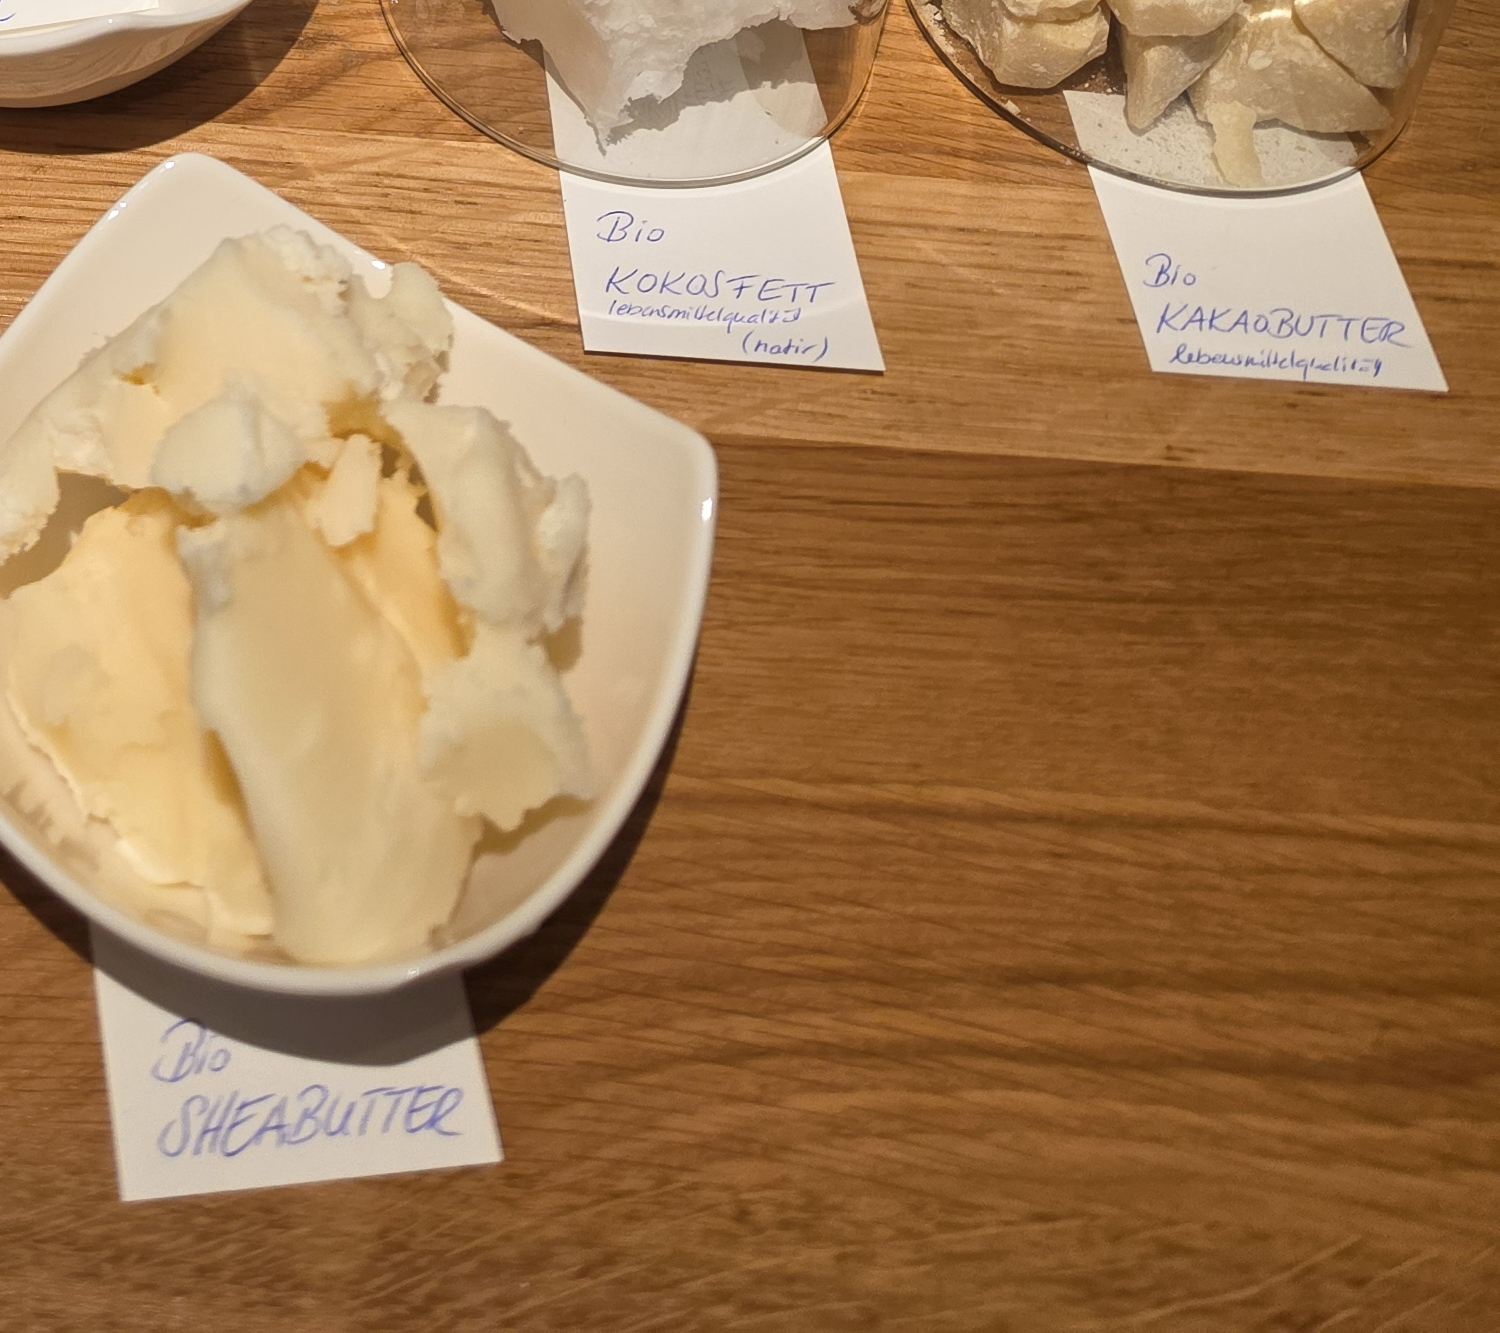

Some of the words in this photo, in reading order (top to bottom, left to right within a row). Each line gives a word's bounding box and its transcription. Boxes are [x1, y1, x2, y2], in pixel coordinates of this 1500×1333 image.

[596, 210, 665, 243] Bio
[604, 265, 838, 304] KOKOSFETT
[1143, 253, 1197, 287] Bio
[1156, 301, 1413, 349] KAKAOBUTTER
[150, 1016, 233, 1083] Bio
[156, 1083, 466, 1158] SHEABUTTER
